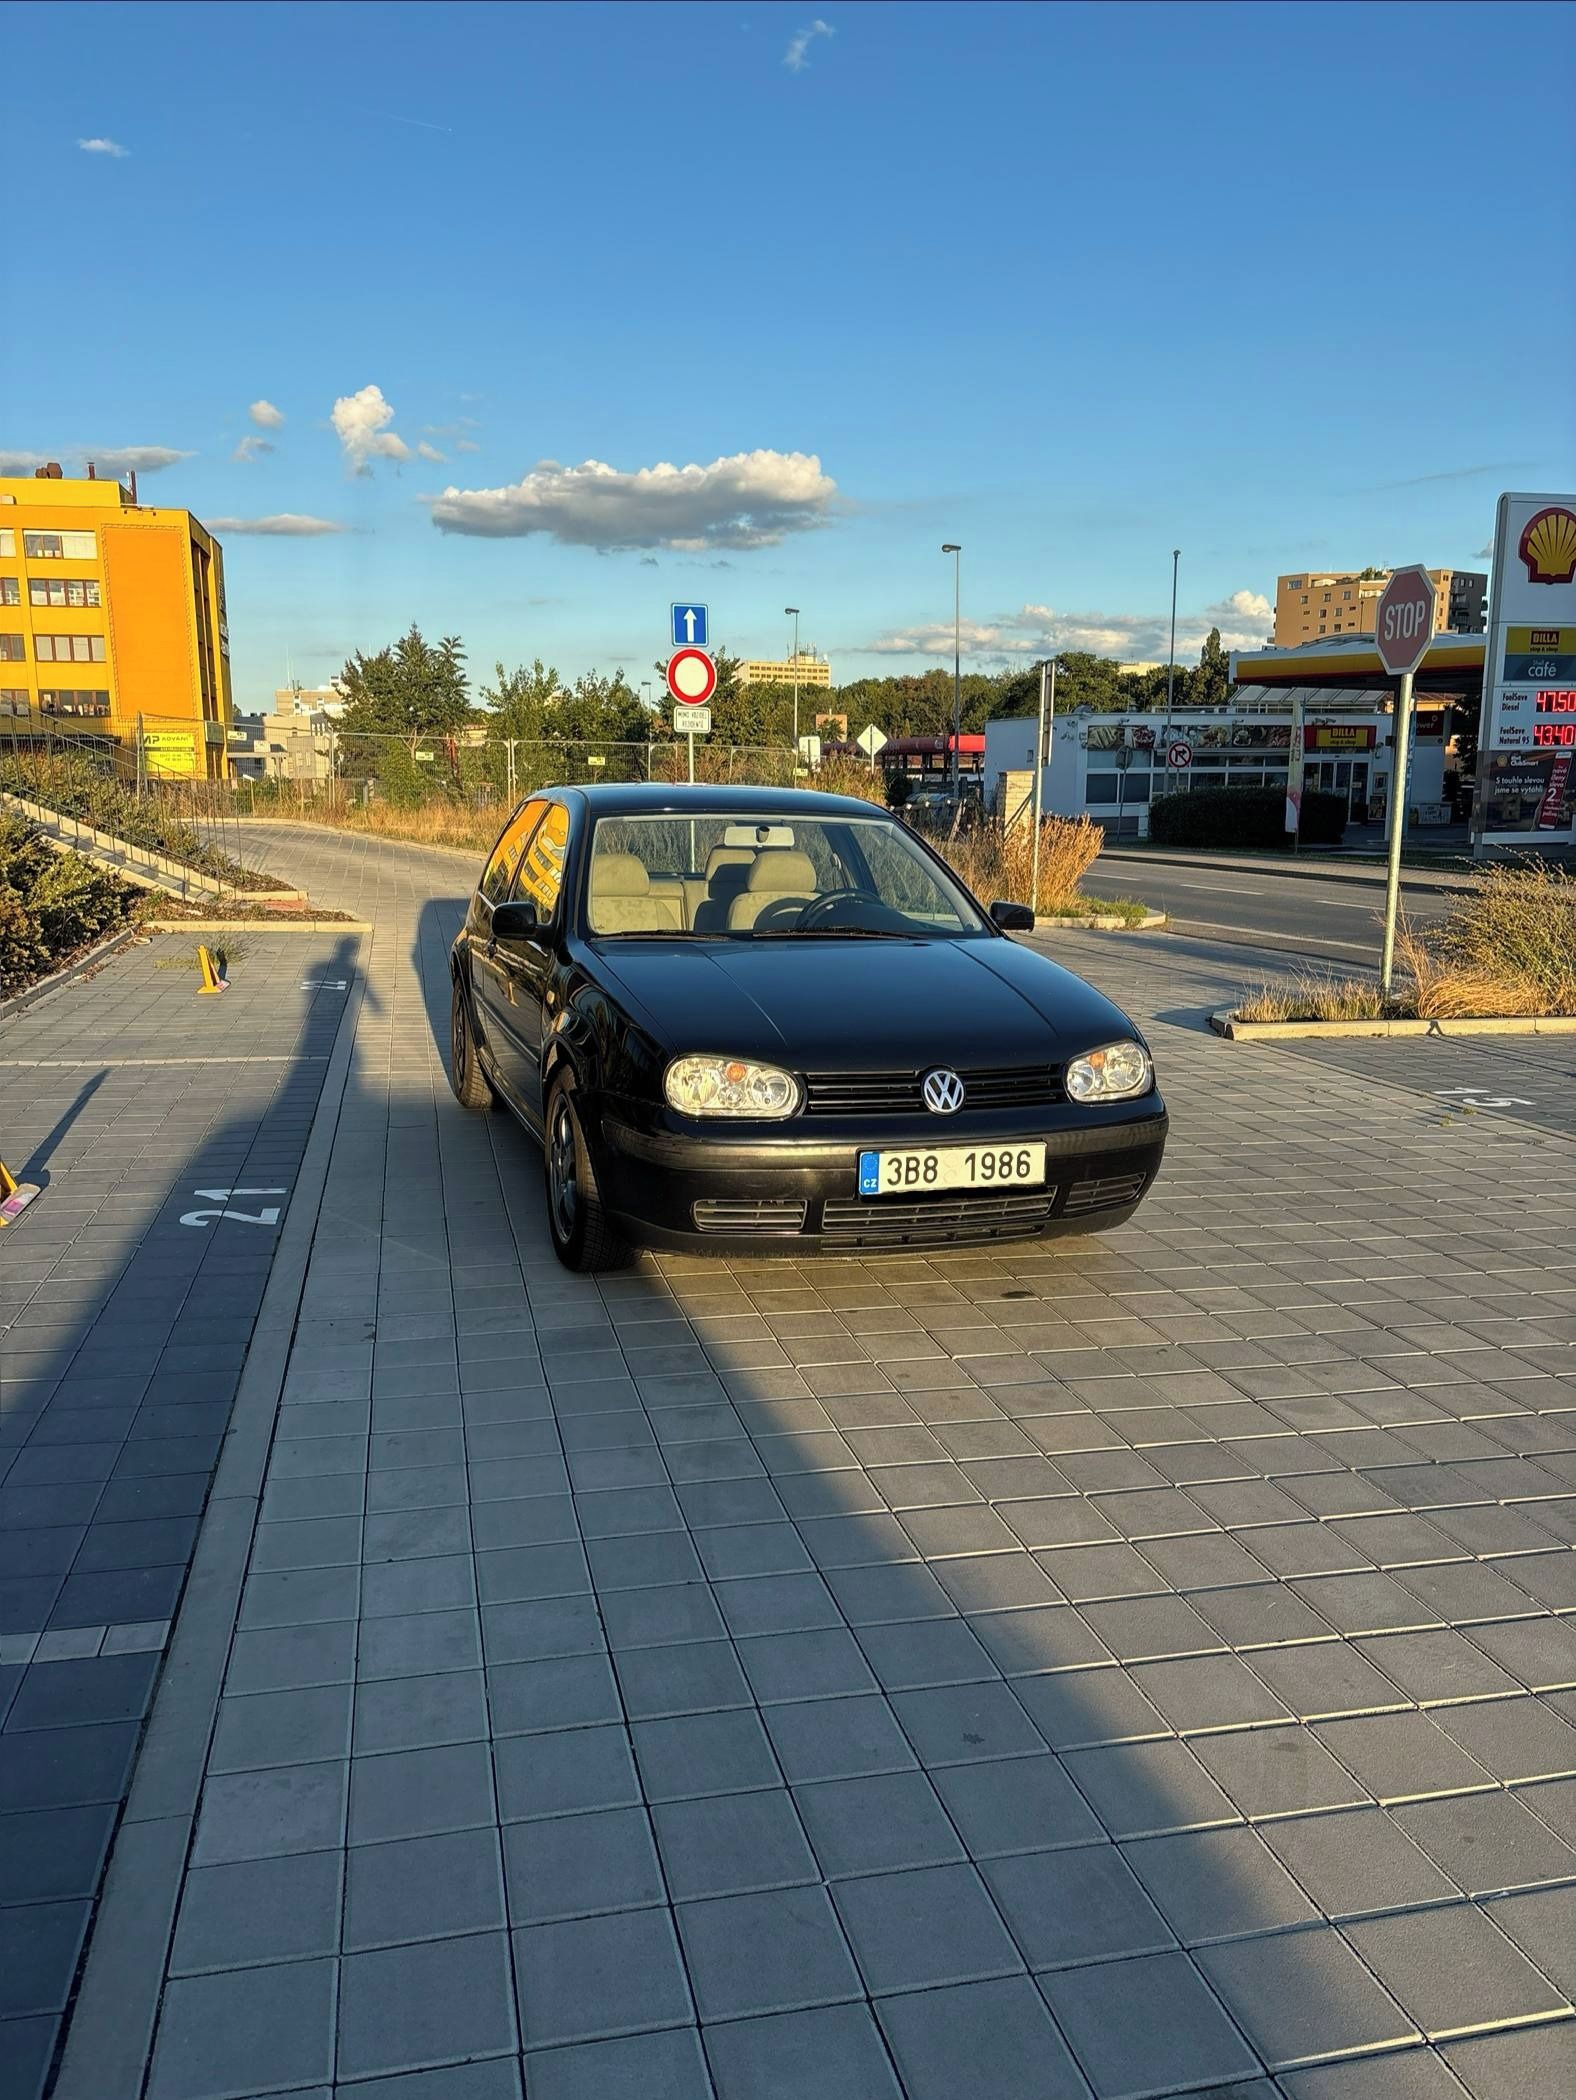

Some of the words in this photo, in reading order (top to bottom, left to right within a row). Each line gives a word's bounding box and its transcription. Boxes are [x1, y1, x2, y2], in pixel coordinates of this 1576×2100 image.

[1384, 600, 1426, 641] STOP
[1532, 632, 1558, 643] BILLA
[1528, 661, 1557, 677] café
[1502, 692, 1528, 701] FuelSave
[1501, 703, 1520, 711] Diesel
[1332, 728, 1355, 737] BILLA
[1500, 725, 1526, 734] FuelSave
[1499, 736, 1521, 744] Natural
[1522, 736, 1530, 744] 95
[1534, 725, 1574, 745] 43.40
[1501, 776, 1523, 784] touhle
[1524, 776, 1545, 784] slevou
[1494, 785, 1510, 795] jsme
[1546, 787, 1557, 801] 2
[299, 980, 347, 990] 22
[886, 1155, 939, 1186] 3B8
[964, 1150, 1032, 1182] 1986
[863, 1178, 877, 1188] CZ
[179, 1187, 288, 1227] 21
